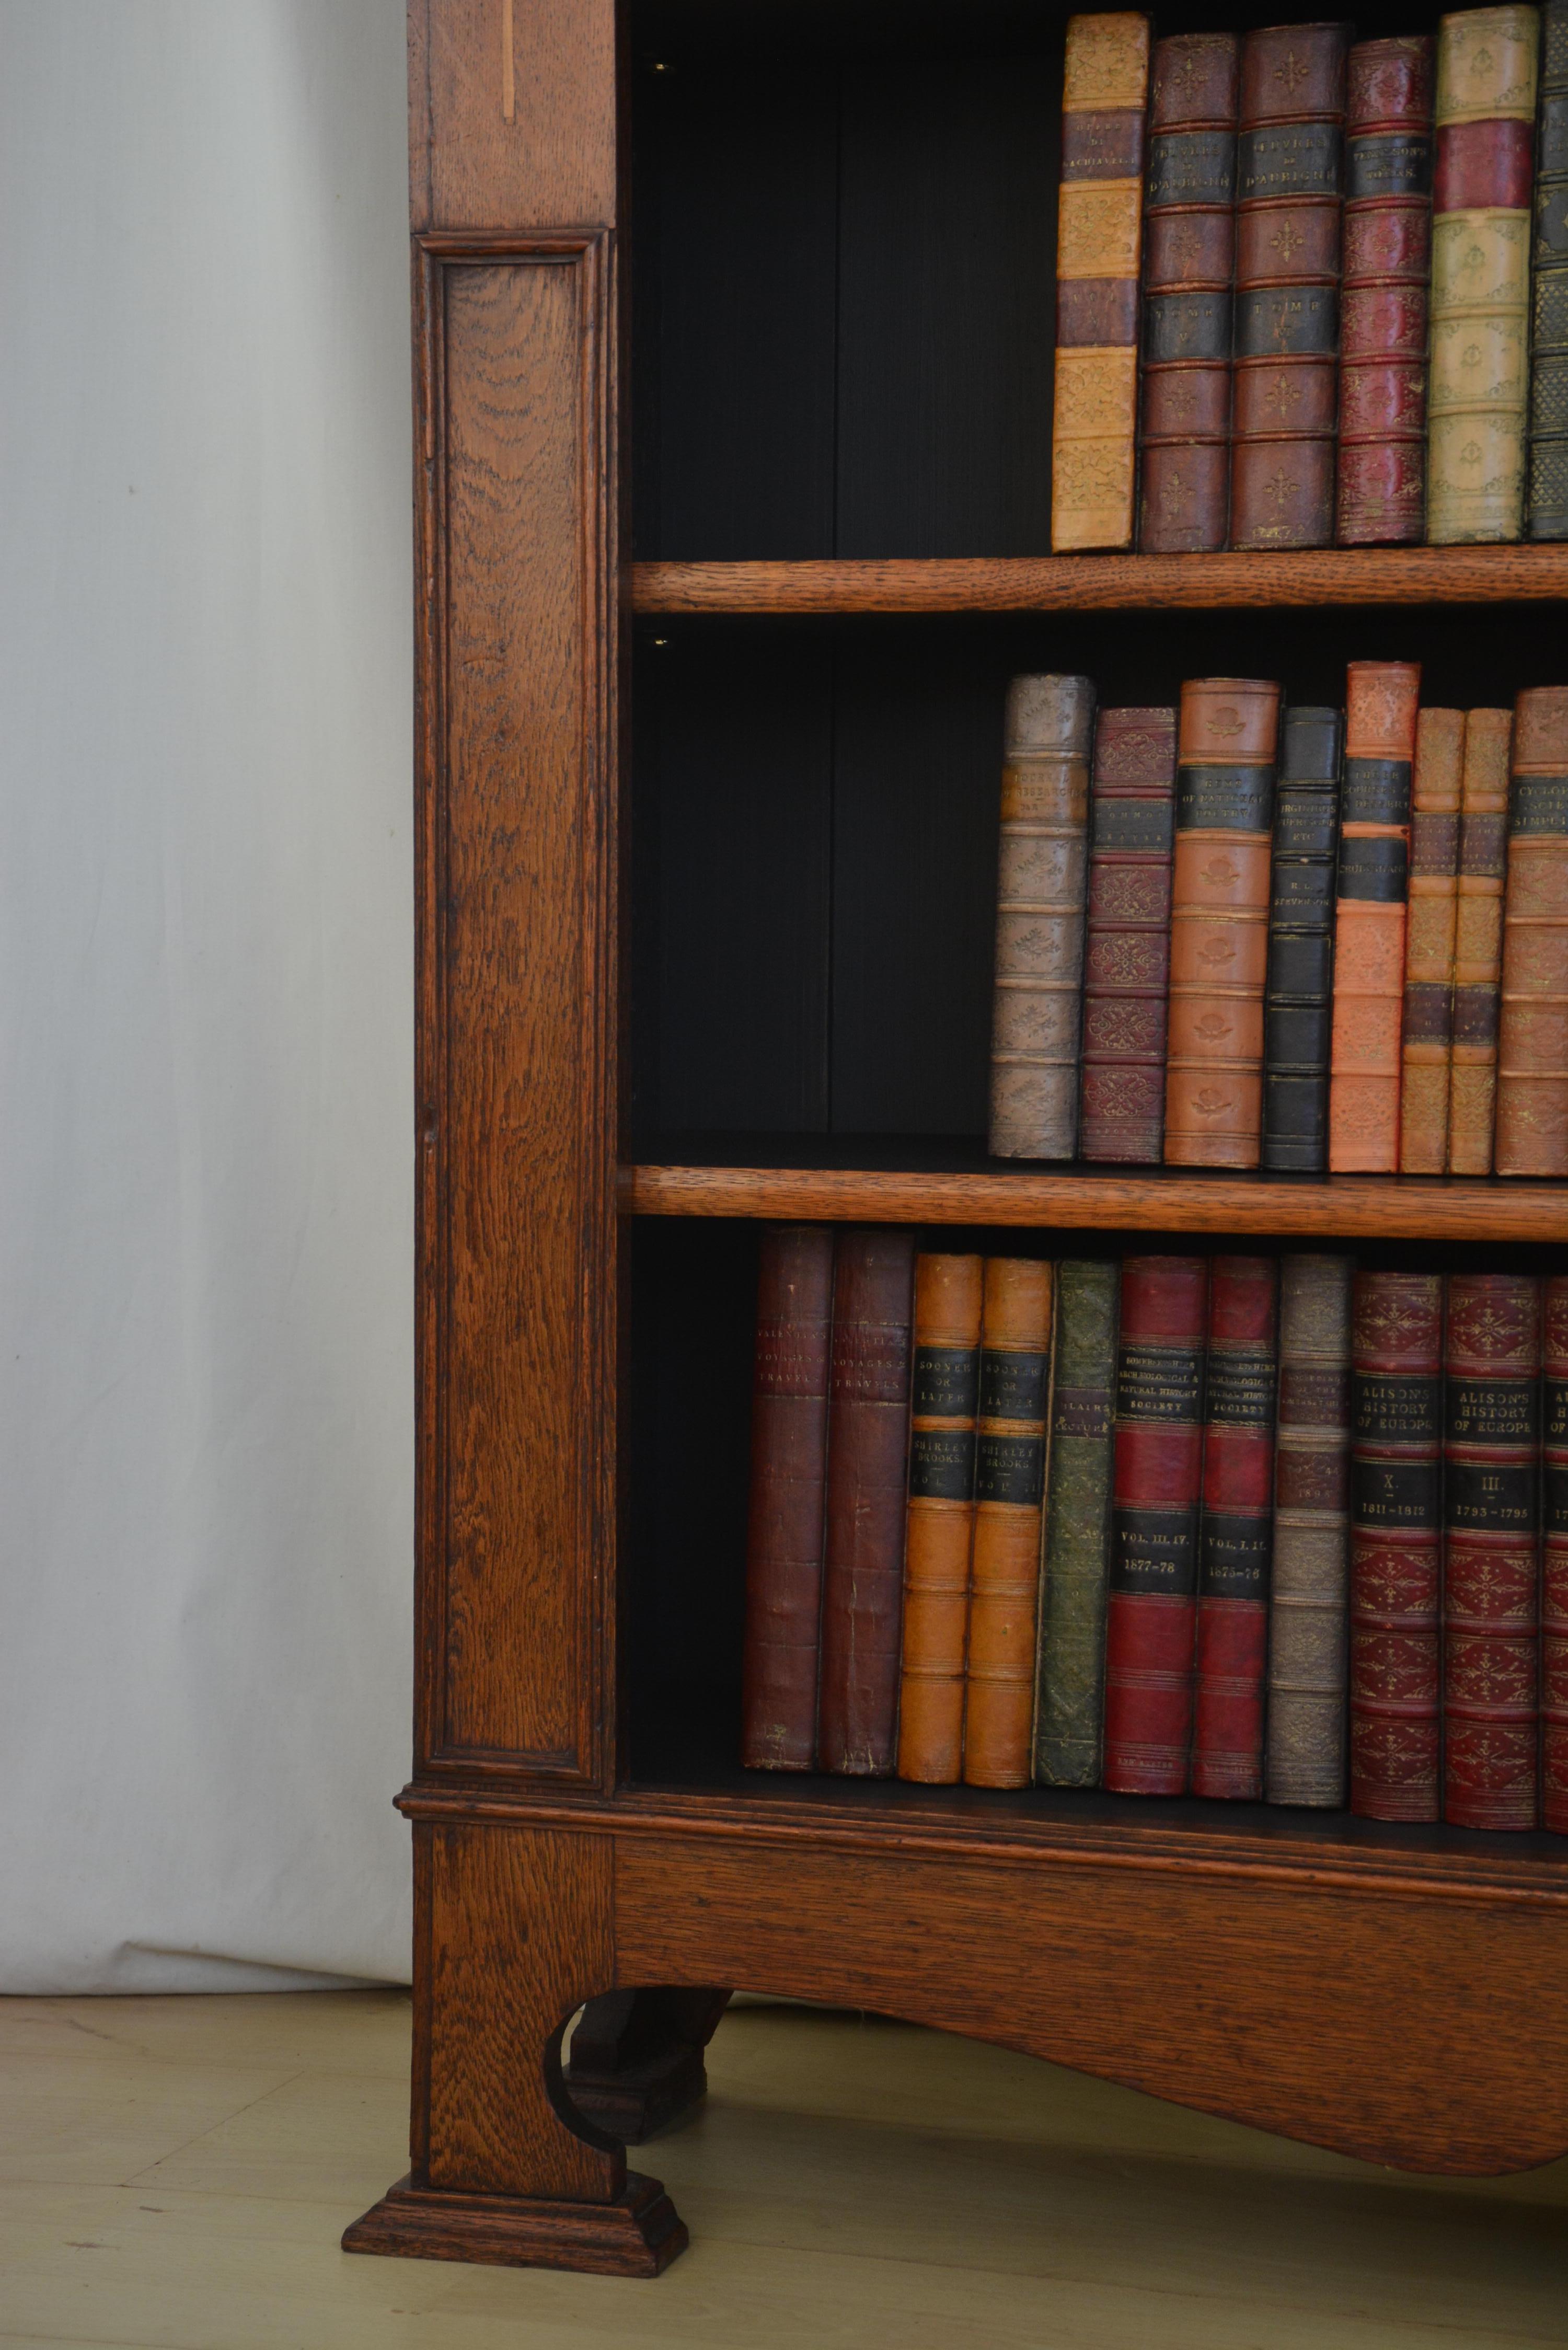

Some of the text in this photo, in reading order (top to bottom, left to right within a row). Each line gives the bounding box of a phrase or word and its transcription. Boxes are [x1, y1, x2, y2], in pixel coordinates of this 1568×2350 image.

[1354, 147, 1426, 162] TENNSON'S
[1284, 156, 1296, 165] DE
[1254, 300, 1321, 315] TOME
[1156, 308, 1213, 320] TOME
[1179, 333, 1187, 342] V
[1014, 774, 1070, 784] JOURNL
[1205, 779, 1242, 788] GEMS
[1343, 786, 1396, 794] COURSES
[1182, 794, 1196, 803] OF
[1195, 808, 1248, 818] POETRY
[1515, 816, 1566, 826] SIMPLI
[1274, 897, 1330, 906] STEVENSON
[758, 1354, 825, 1363] VOYAGES &
[920, 1361, 971, 1373] SOONER
[986, 1365, 1039, 1376] SOONER
[759, 1373, 819, 1382] TRAVELS
[936, 1378, 950, 1386] OR
[836, 1379, 899, 1389] TRAVELS
[1003, 1383, 1017, 1391] OR
[921, 1391, 965, 1402] LATER
[1120, 1385, 1197, 1398] NATURAL HISTORY
[1363, 1387, 1430, 1400] ALISON'S
[988, 1397, 1033, 1408] LATER
[1459, 1392, 1529, 1404] ALISON'S
[1131, 1401, 1182, 1411] SOCIETY
[1214, 1403, 1265, 1413] SOCIETY
[1363, 1402, 1427, 1415] HISTORY
[1461, 1406, 1527, 1418] HISTORY
[1358, 1416, 1433, 1431] OF EUROPE
[1455, 1420, 1531, 1433] OF EUROPE
[1550, 1422, 1566, 1433] OF
[915, 1440, 968, 1452] SHIRLEY
[982, 1445, 1033, 1457] SHIRLEY
[918, 1453, 964, 1463] BROOKS.
[1384, 1474, 1399, 1489] X.
[1481, 1477, 1505, 1490] III.
[1121, 1531, 1190, 1545] VOL. III. IV.
[1208, 1537, 1236, 1549] VOL.
[1240, 1540, 1249, 1550] I.
[1125, 1558, 1175, 1573] 1877-78
